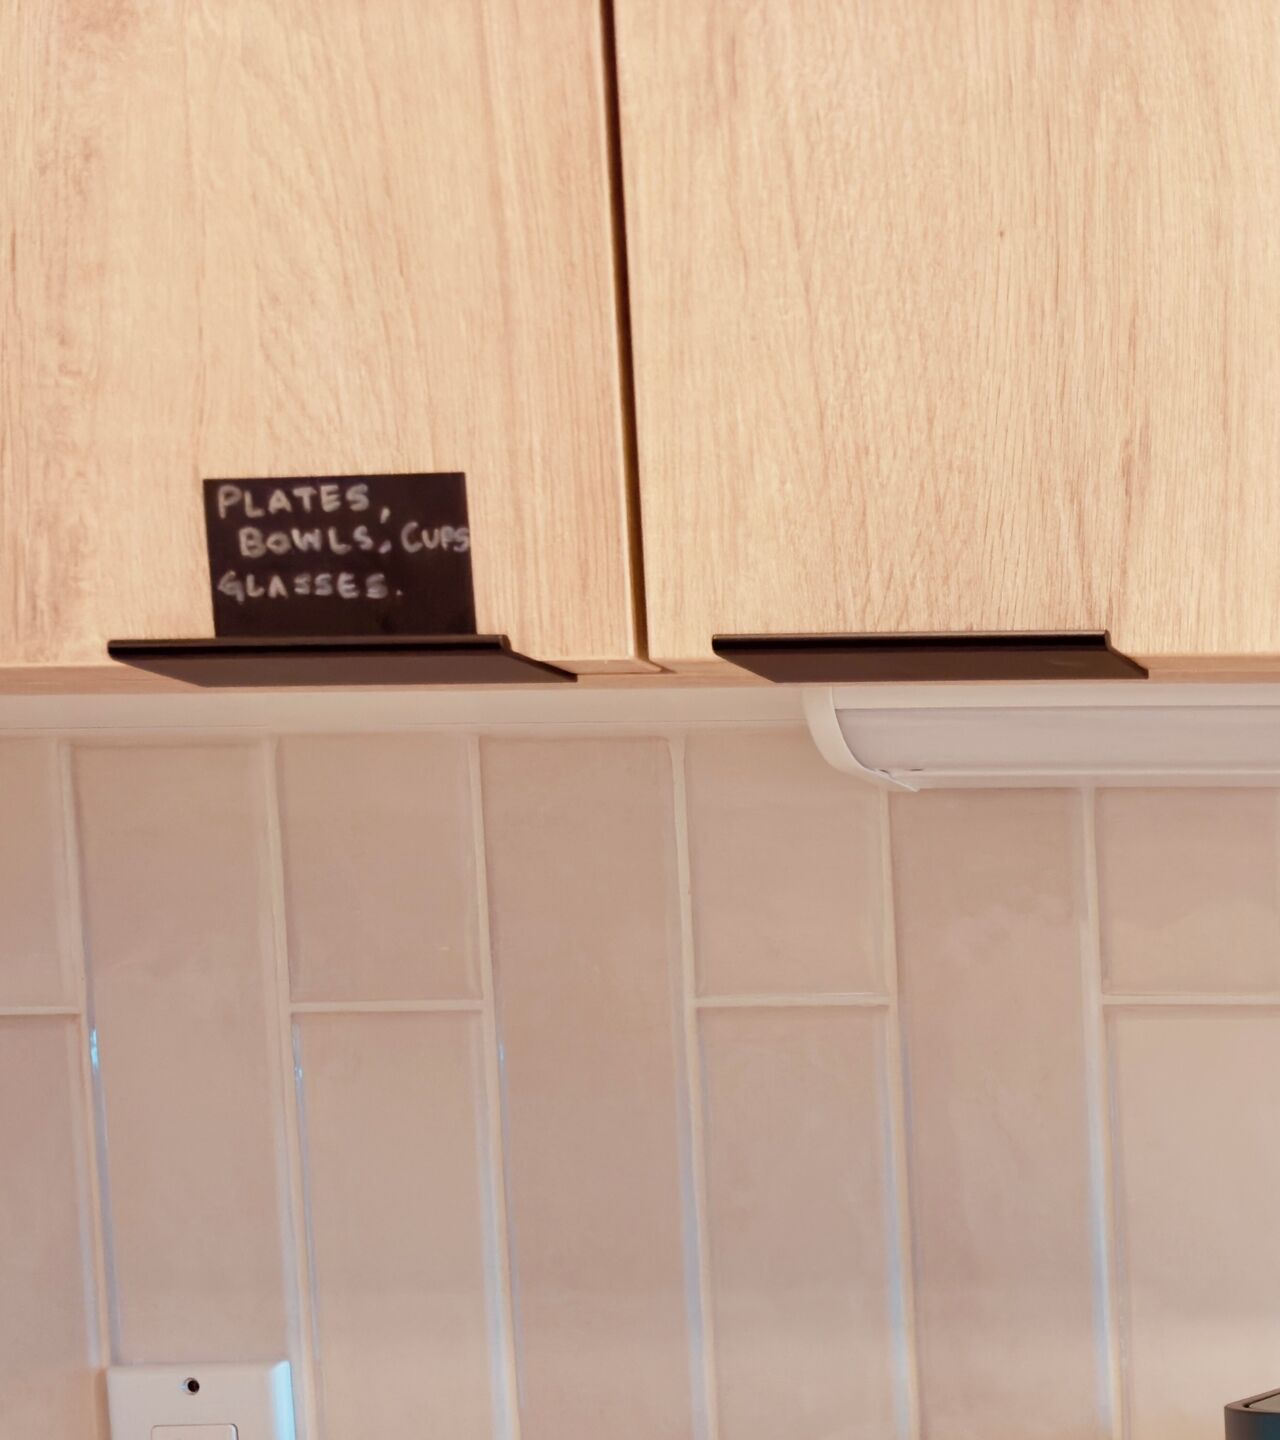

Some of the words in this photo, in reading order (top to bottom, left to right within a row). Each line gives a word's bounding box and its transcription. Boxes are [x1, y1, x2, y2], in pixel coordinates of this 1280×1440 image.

[217, 483, 391, 524] PLATES,
[400, 521, 471, 553] CUPS
[217, 570, 403, 605] GLASSES.
